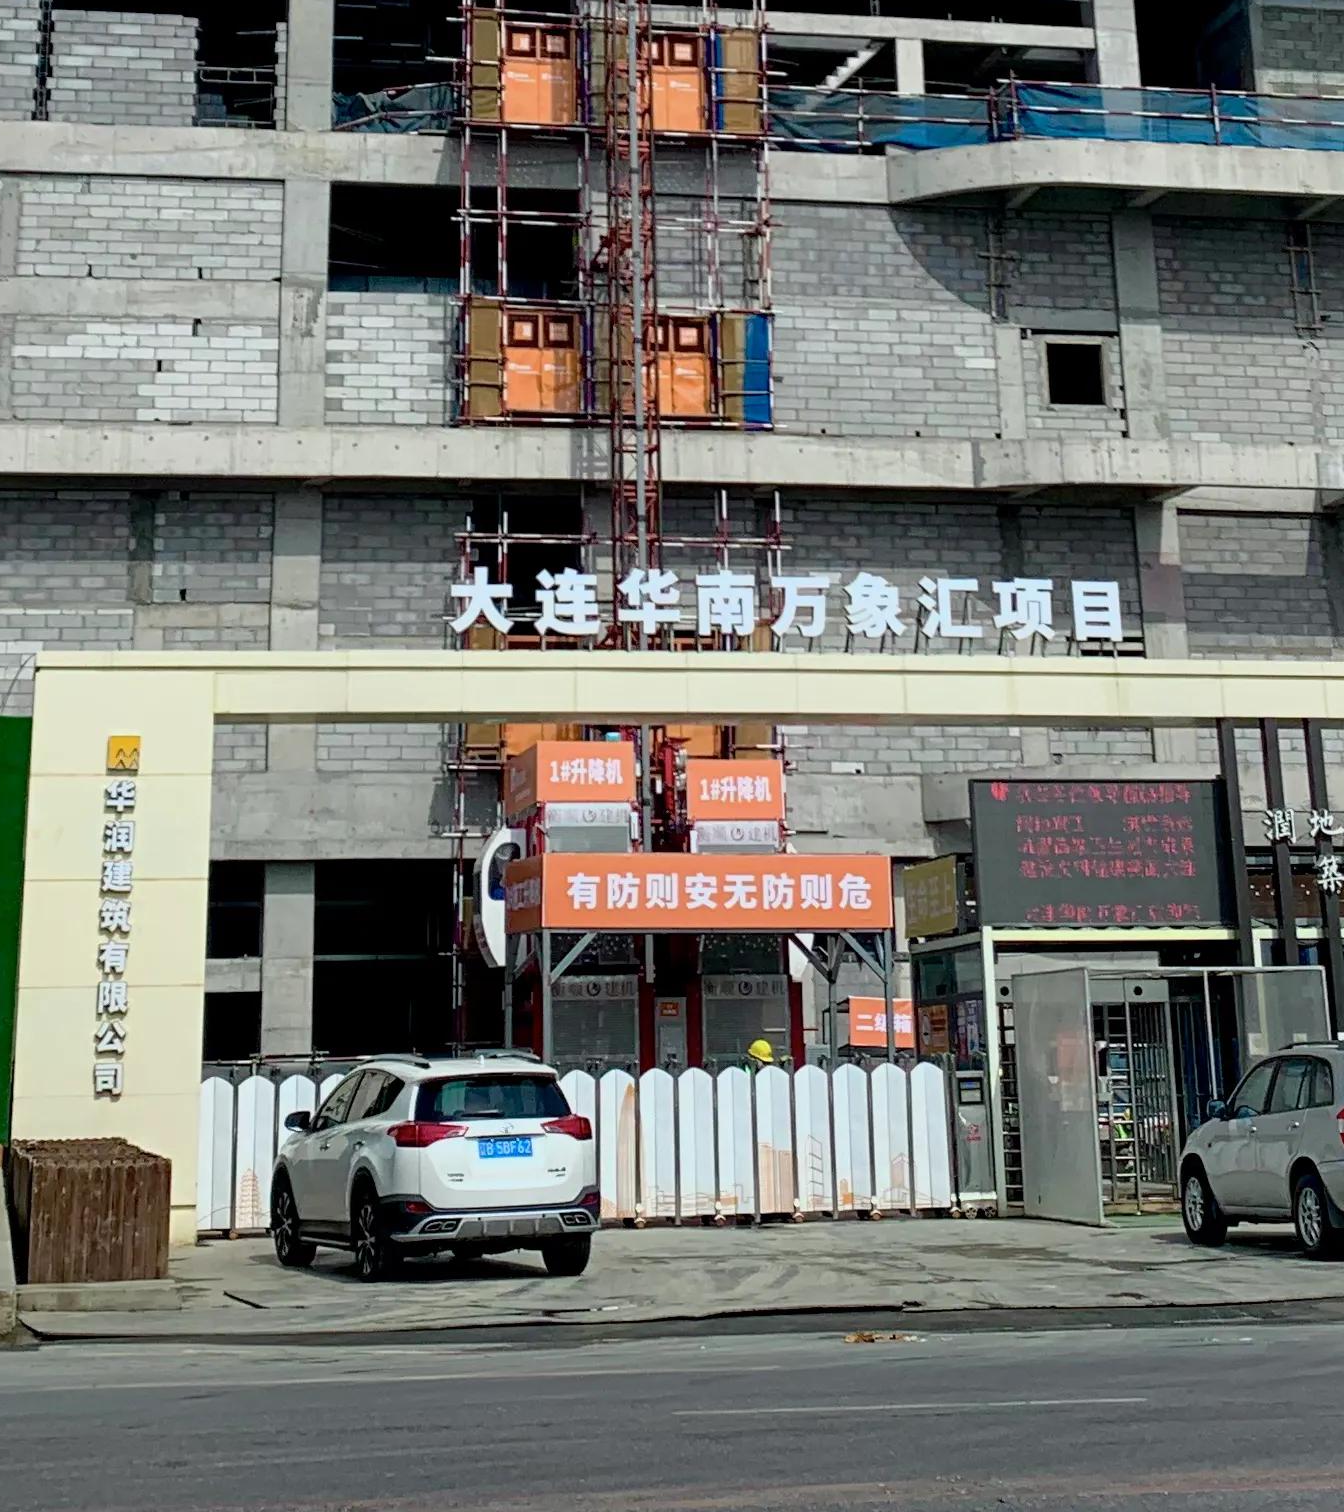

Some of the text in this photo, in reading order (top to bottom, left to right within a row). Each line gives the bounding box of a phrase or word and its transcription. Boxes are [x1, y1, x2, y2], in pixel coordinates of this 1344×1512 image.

[450, 567, 1123, 643] 大连华南万象汇项目
[549, 757, 624, 785] 1#升降机
[700, 775, 772, 802] 1#升降机
[567, 872, 873, 911] 有防则安无防则危
[93, 780, 137, 1099] 华润建筑有限公司
